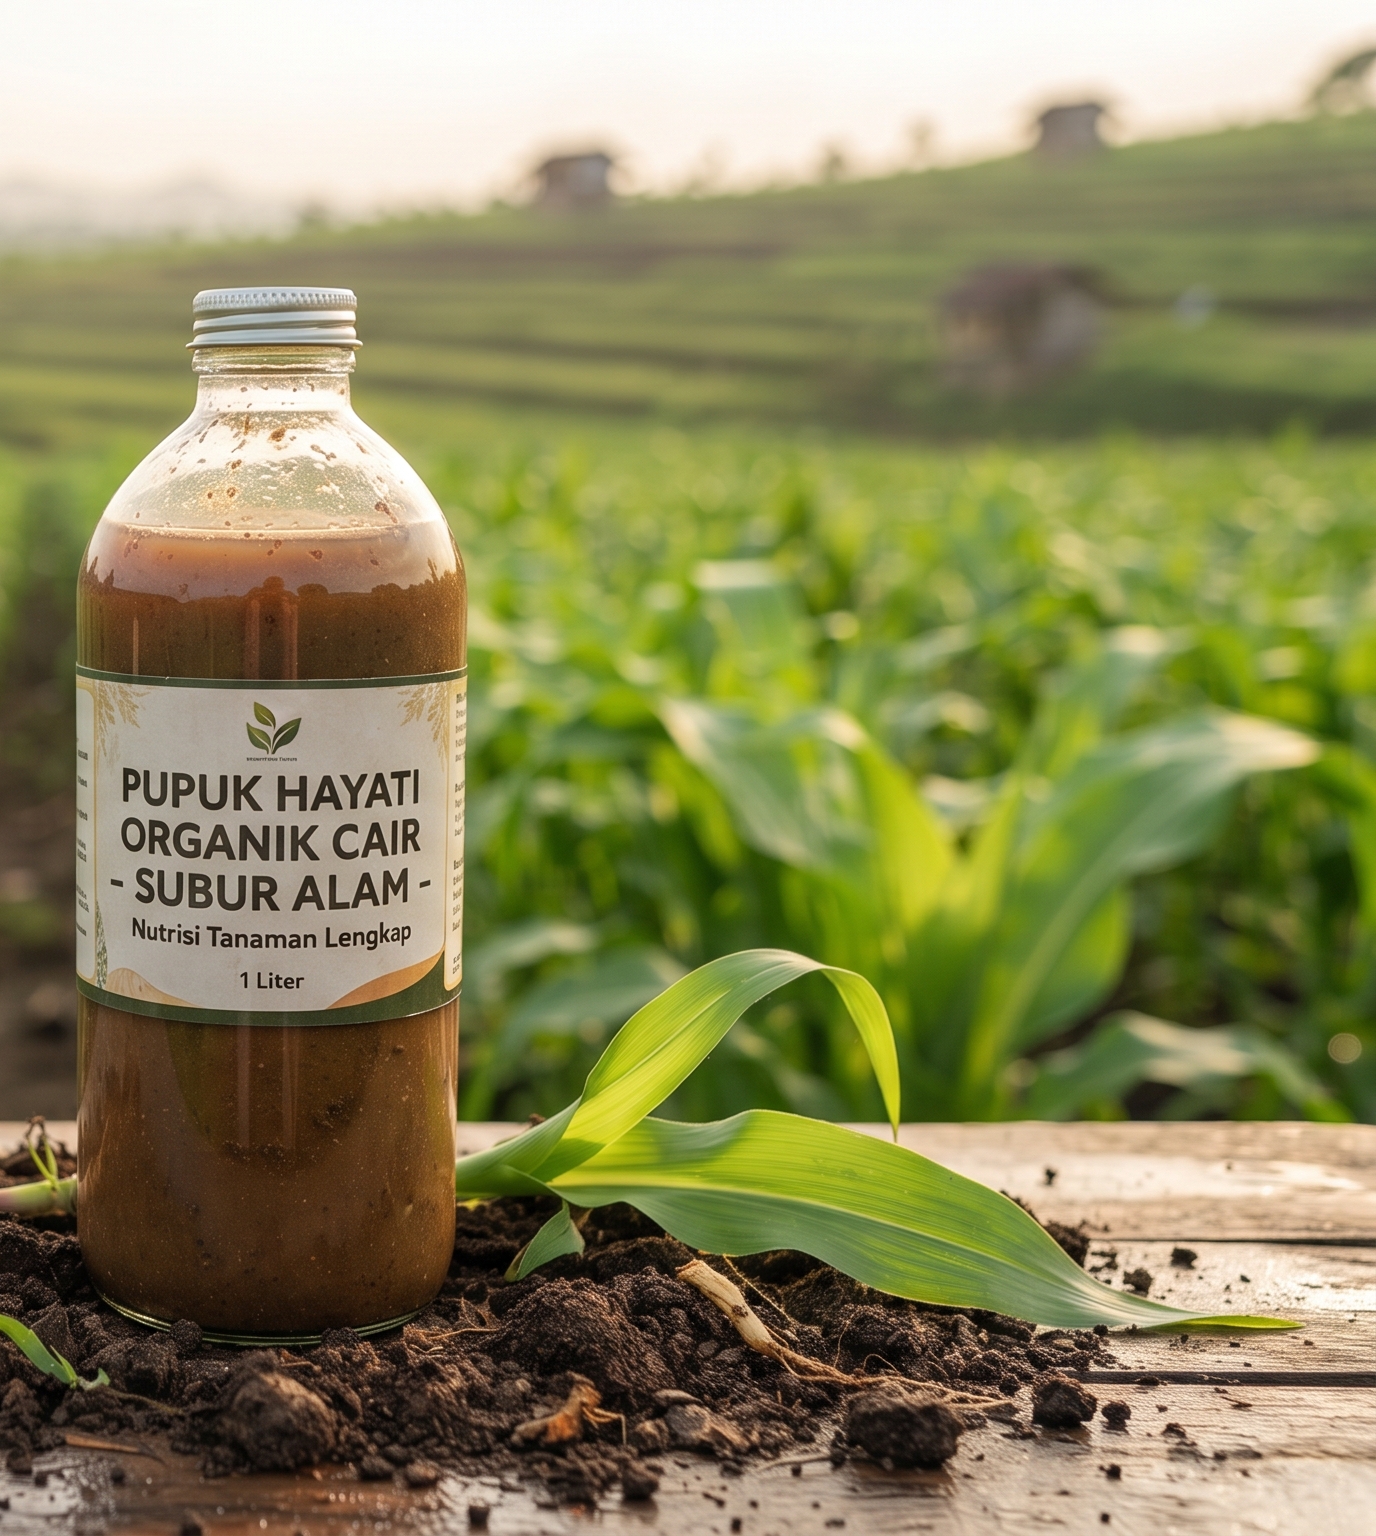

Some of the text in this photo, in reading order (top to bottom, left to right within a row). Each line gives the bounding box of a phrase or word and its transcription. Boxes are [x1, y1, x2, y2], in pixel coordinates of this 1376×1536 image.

[122, 767, 264, 812] PUPUK
[277, 768, 420, 812] HAYATI
[120, 816, 321, 862] ORGANIK
[332, 818, 421, 861] CAIR
[134, 867, 281, 912] SUBUR
[291, 867, 409, 912] ALAM
[132, 916, 412, 951] Nutrisi Tanaman Lengkap
[239, 971, 305, 990] 1 Liter
